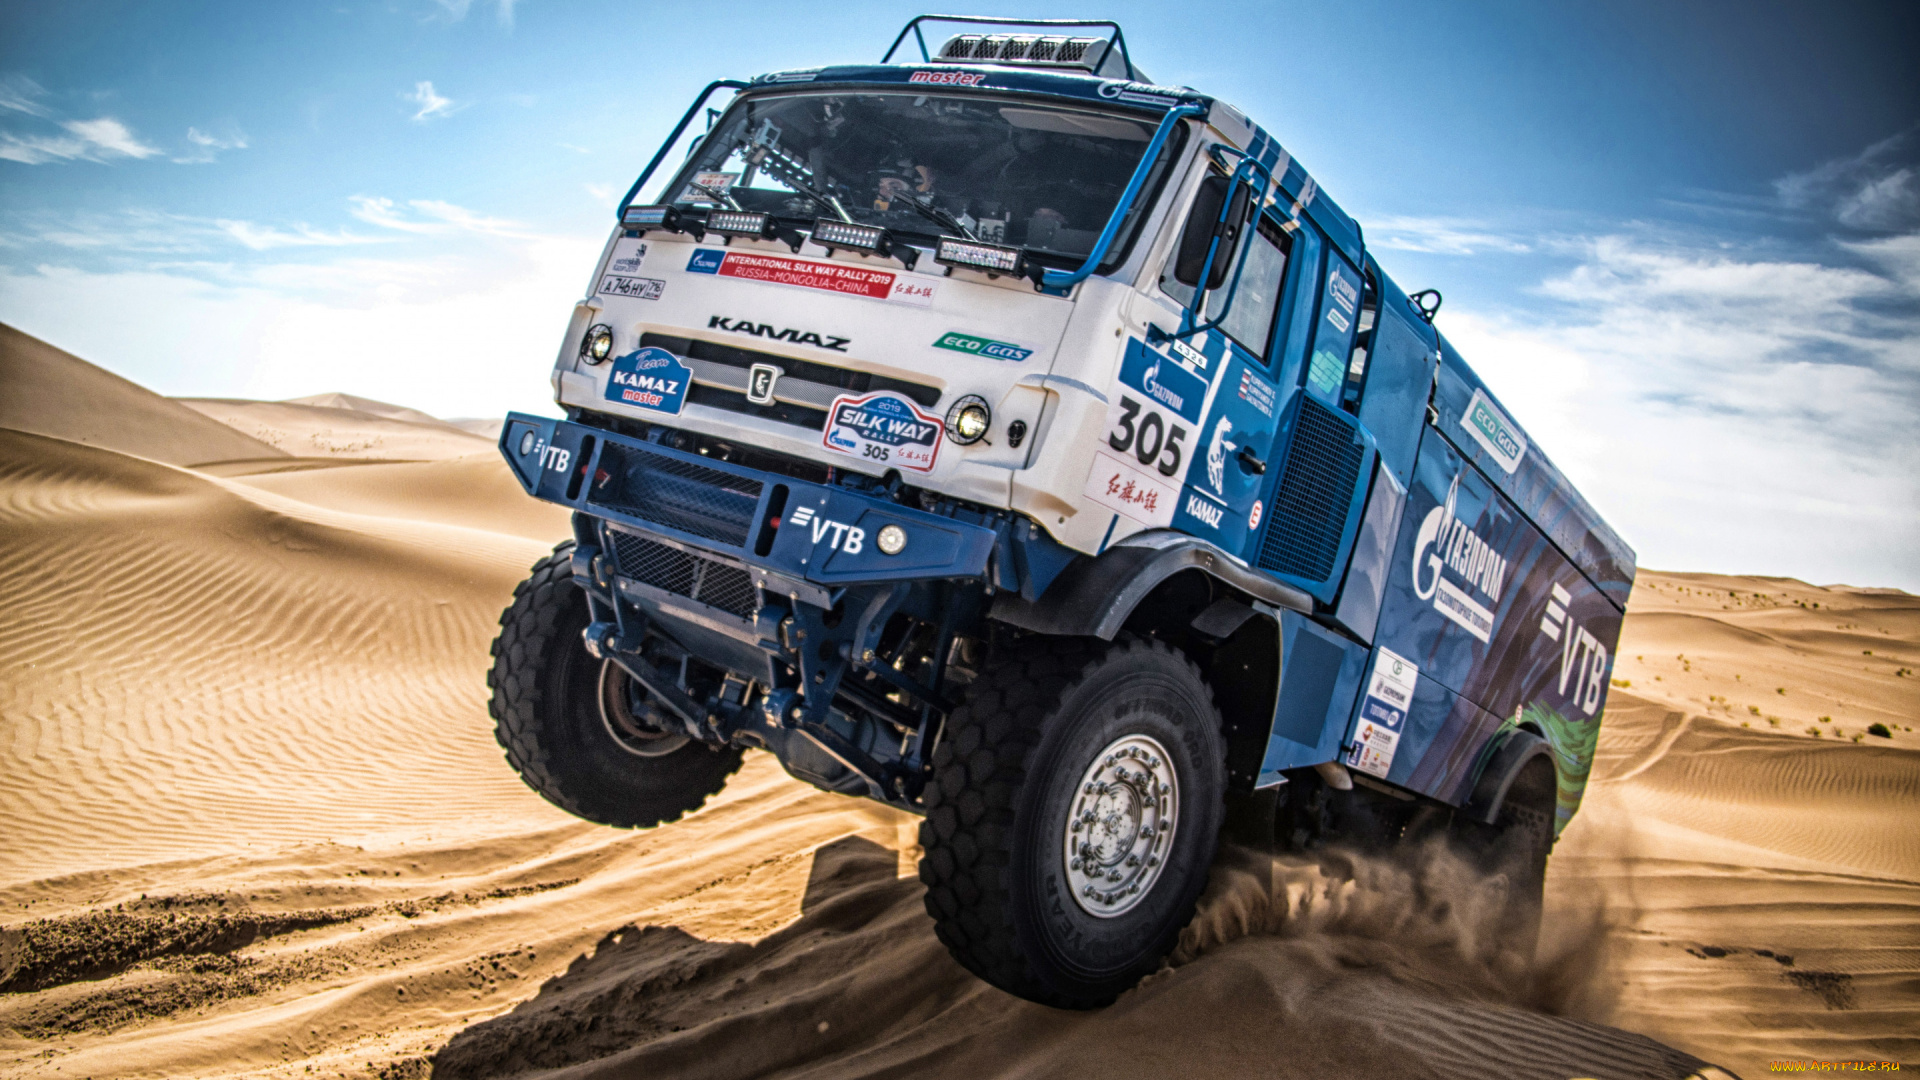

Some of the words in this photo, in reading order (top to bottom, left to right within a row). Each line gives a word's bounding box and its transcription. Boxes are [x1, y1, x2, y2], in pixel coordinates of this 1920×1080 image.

[909, 71, 986, 86] master
[726, 255, 792, 270] INTERNATIONAL
[793, 263, 812, 273] SILK
[815, 265, 836, 275] WAY
[837, 268, 868, 280] RALLY
[869, 274, 891, 284] 2019
[707, 315, 852, 352] KAMAZ
[943, 336, 980, 350] ECO
[986, 345, 1028, 359] GAS
[635, 350, 669, 371] Team
[1177, 343, 1203, 365] 4326
[613, 370, 679, 394] KAMAZ
[622, 388, 664, 407] master
[878, 402, 901, 412] 2019
[1153, 382, 1184, 411] GAZPROM
[839, 409, 887, 431] SILK
[887, 419, 932, 440] WAY
[862, 430, 899, 443] RALLY
[1108, 394, 1186, 477] 305
[1476, 408, 1496, 434] ECO
[1498, 432, 1518, 457] GAS
[539, 445, 570, 473] VTB
[862, 443, 890, 461] 305
[1185, 494, 1224, 530] KAMAZ
[1251, 505, 1261, 525] E
[812, 516, 866, 555] VTB
[1444, 517, 1507, 603] ГАЗПРОМ
[1558, 615, 1607, 717] VTB
